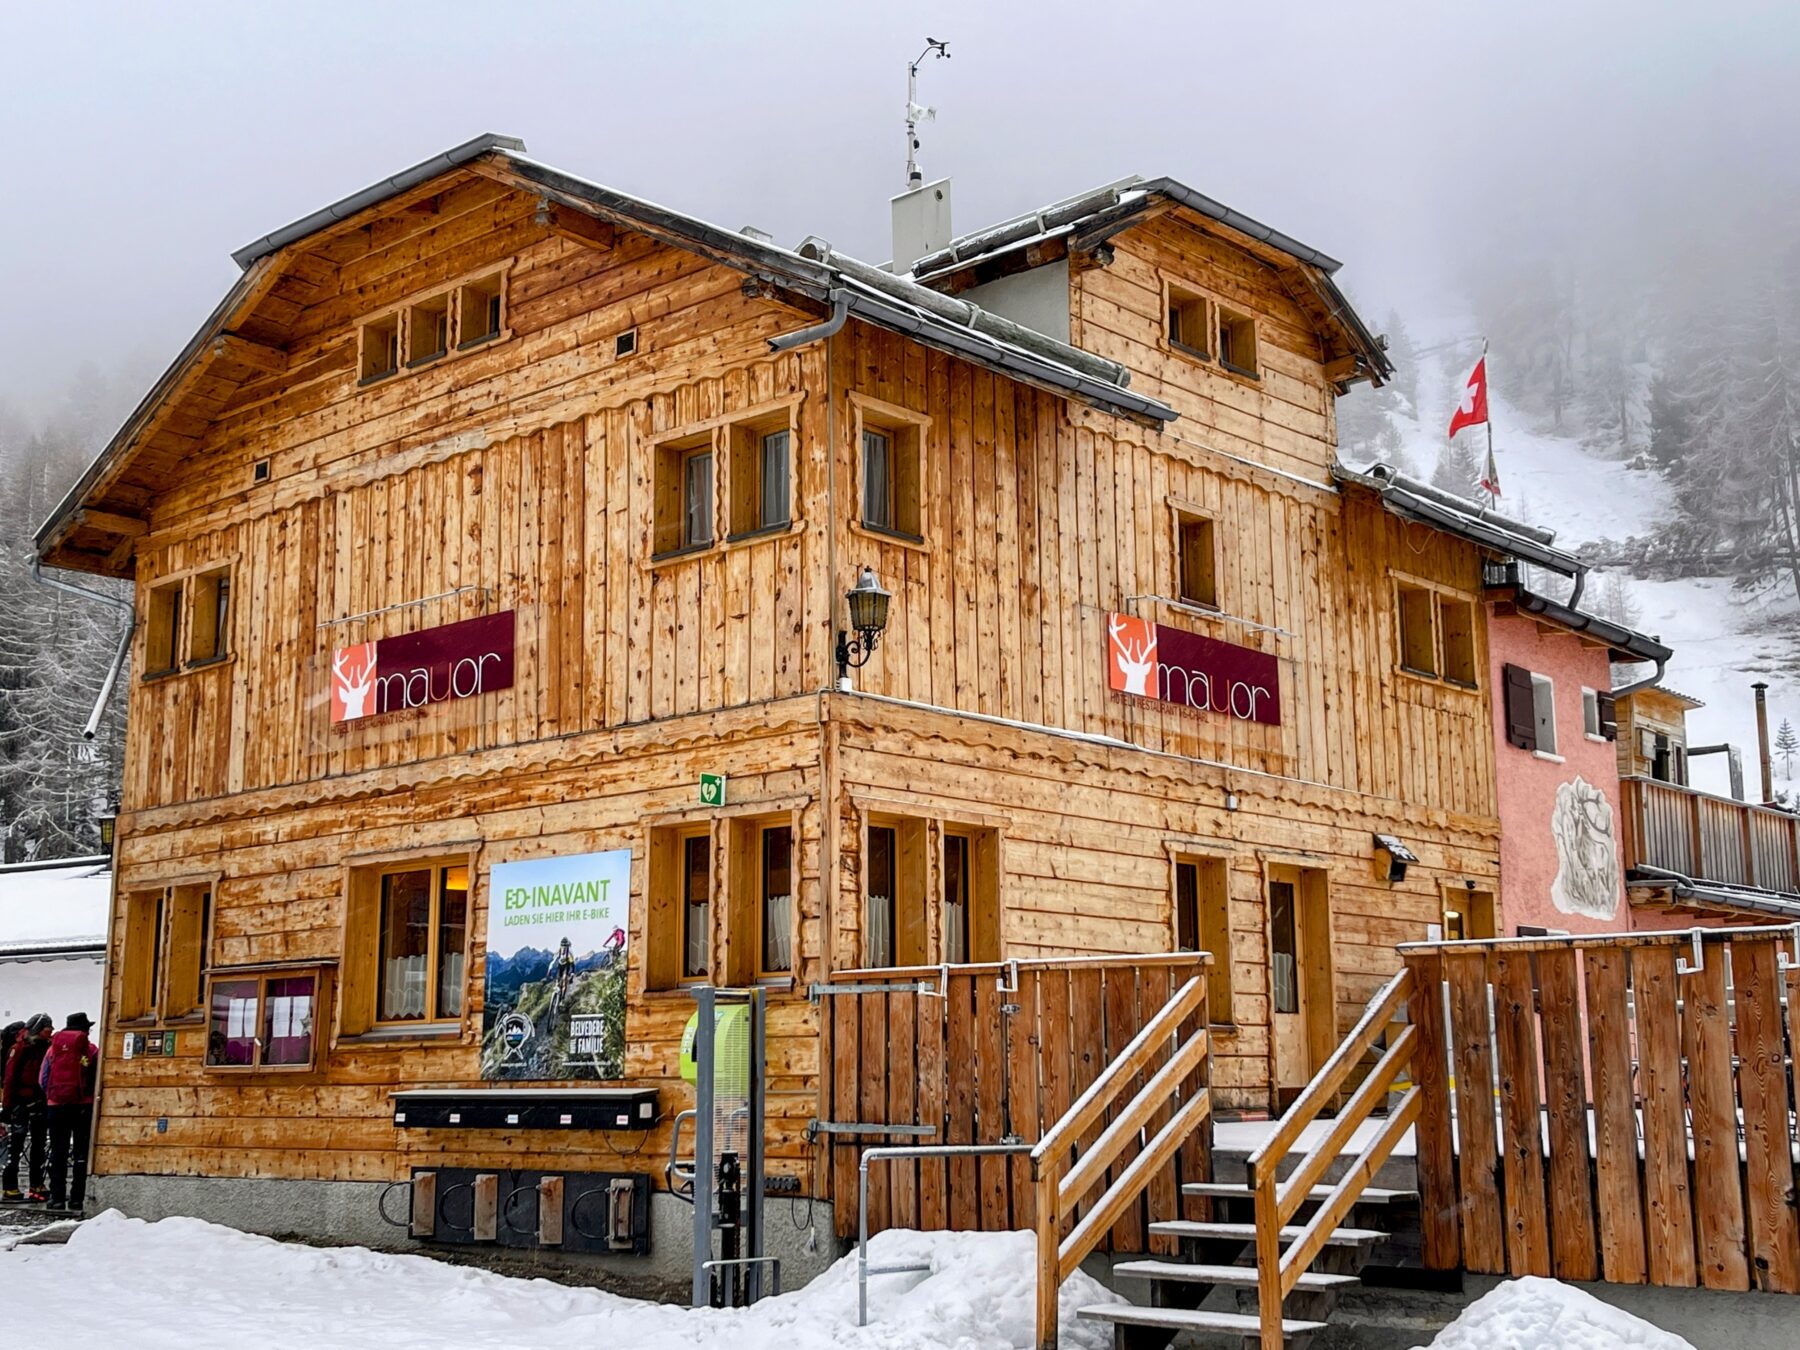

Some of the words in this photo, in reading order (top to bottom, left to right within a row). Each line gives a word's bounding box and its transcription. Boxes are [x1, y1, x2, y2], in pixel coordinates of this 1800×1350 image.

[375, 652, 501, 716] mayor
[1157, 662, 1271, 728] mayor
[532, 879, 611, 908] INAVANT
[504, 915, 530, 927] LADEN
[531, 913, 544, 925] SIE
[545, 911, 564, 923] HIER
[566, 909, 581, 921] IHR
[583, 907, 610, 920] E-BIKE
[570, 1020, 604, 1037] BELVEDERE
[577, 1037, 604, 1054] FAMILIE
